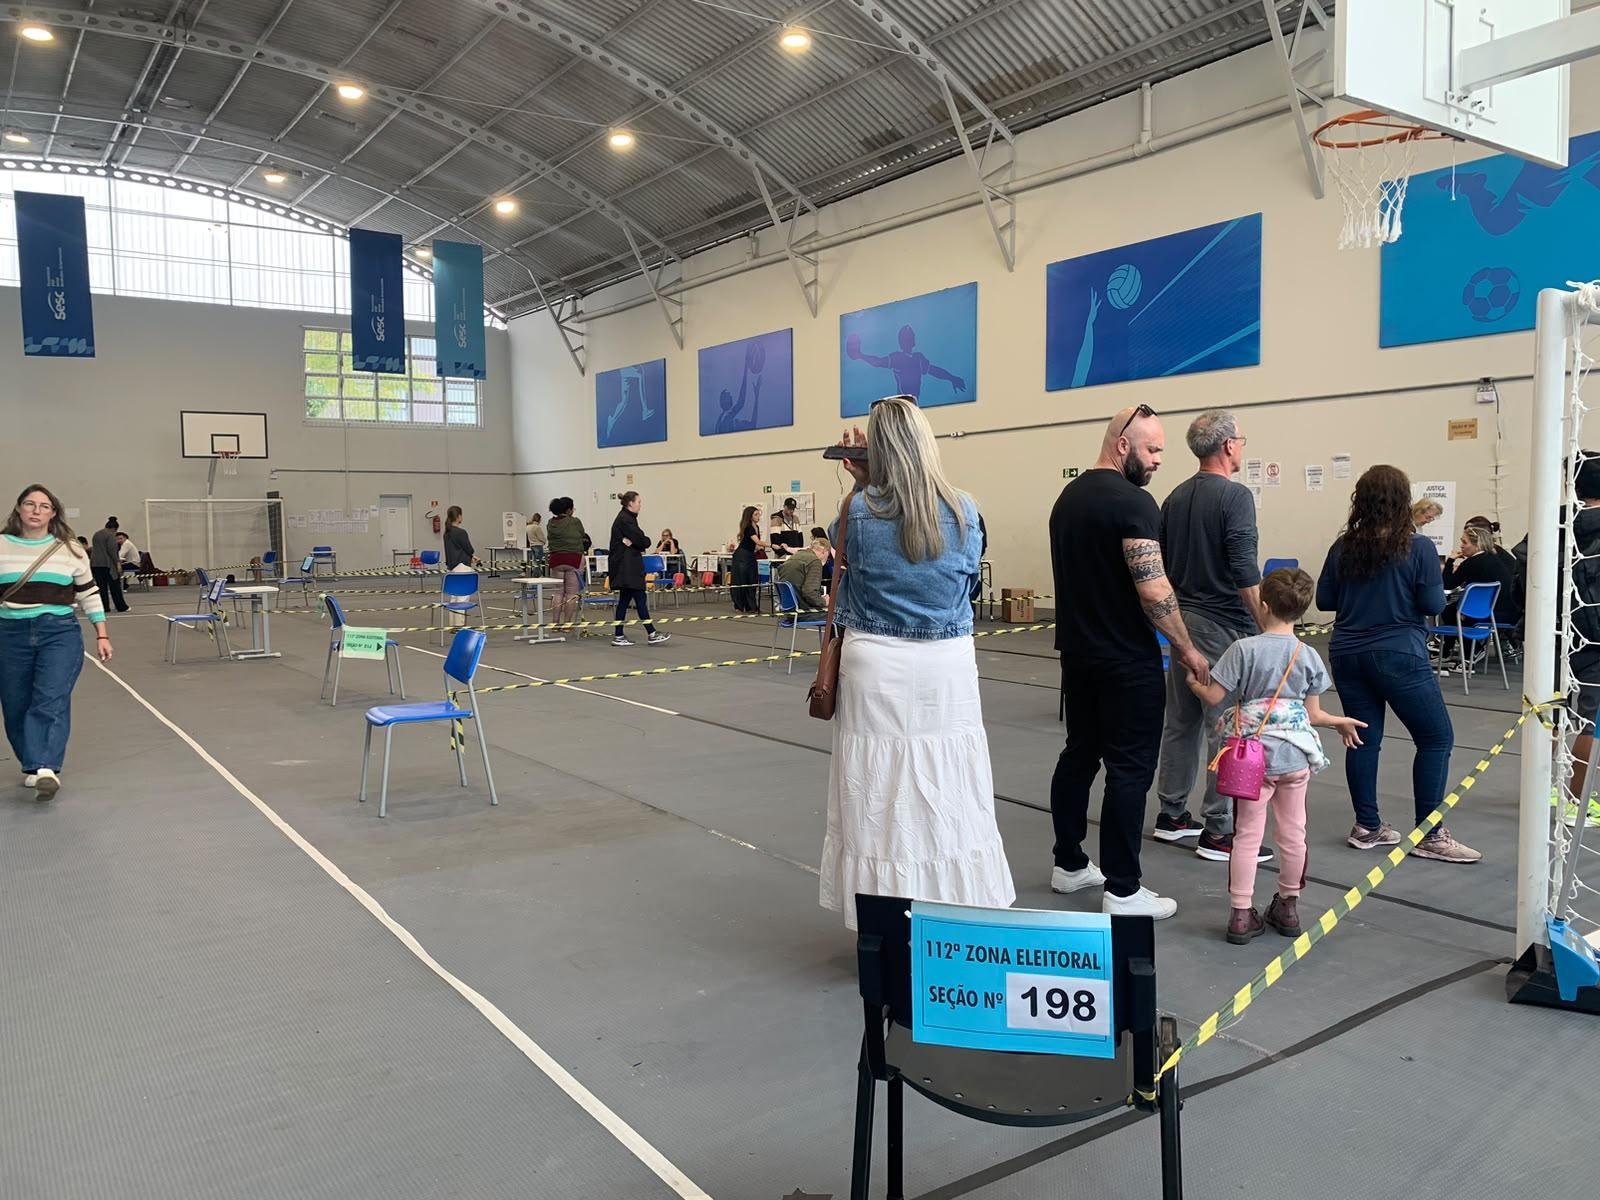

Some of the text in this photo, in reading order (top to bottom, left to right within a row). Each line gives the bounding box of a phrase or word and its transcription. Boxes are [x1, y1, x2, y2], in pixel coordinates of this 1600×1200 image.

[1426, 485, 1446, 493] JUSTIÇA
[926, 940, 1102, 970] 112ª ZONA ELEITORAL
[929, 984, 1097, 1022] SEÇÃO Nº 198
